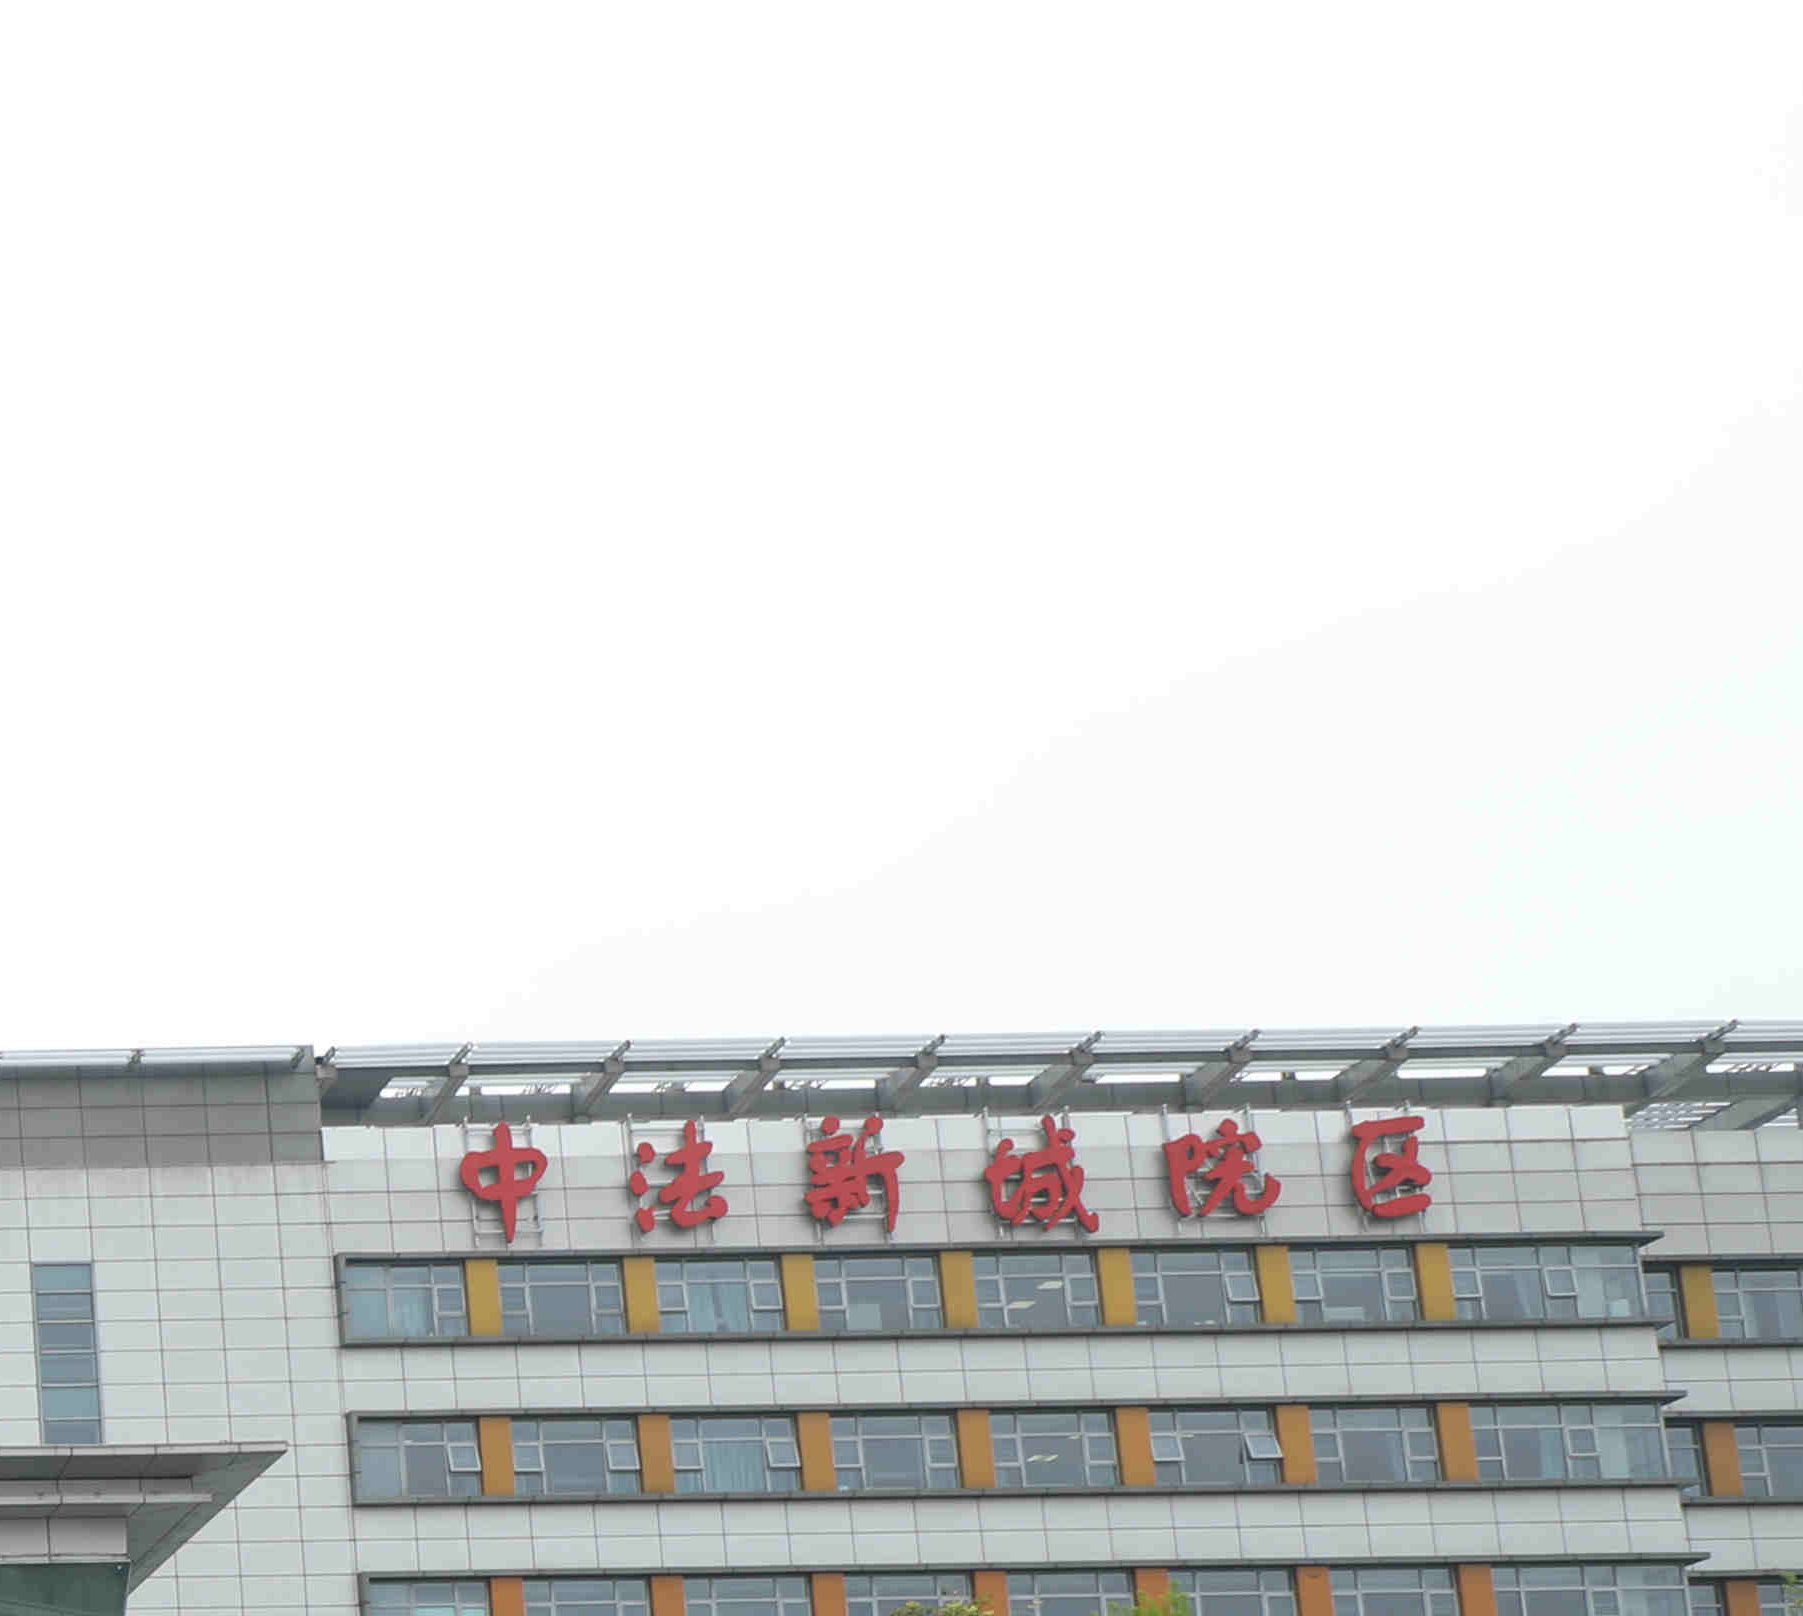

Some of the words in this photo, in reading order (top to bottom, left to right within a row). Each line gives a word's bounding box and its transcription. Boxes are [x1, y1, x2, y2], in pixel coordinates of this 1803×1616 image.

[460, 1115, 1433, 1243] 中法新城院区
